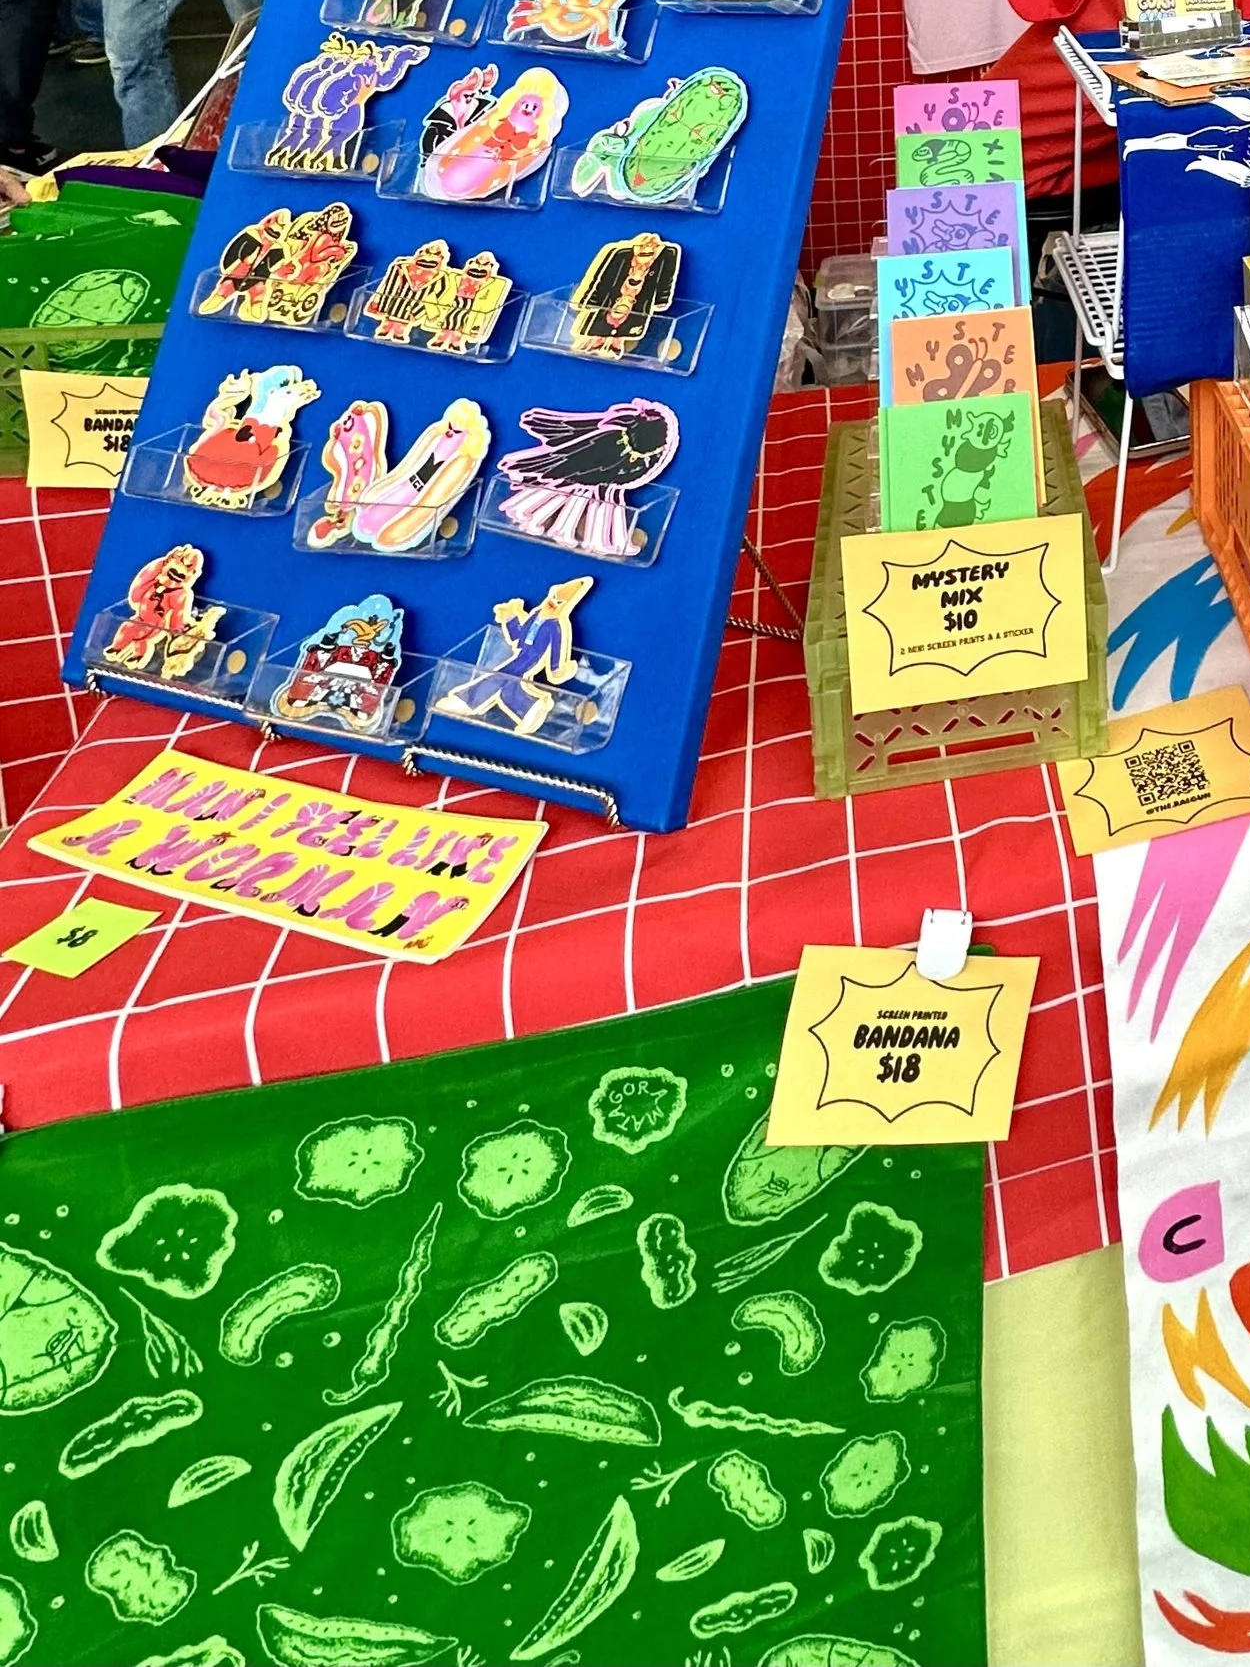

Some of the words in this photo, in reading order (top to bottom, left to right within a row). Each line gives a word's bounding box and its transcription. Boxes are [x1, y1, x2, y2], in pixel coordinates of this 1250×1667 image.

[84, 418, 138, 432] BANDA
[103, 434, 131, 452] $18
[912, 561, 1010, 590] MYSTERY
[941, 586, 983, 608] MIX
[944, 609, 978, 632] $10
[927, 640, 957, 651] SCREEN
[959, 635, 985, 646] PRINTS
[1003, 628, 1034, 638] STICKER
[122, 767, 266, 821] MAN
[270, 801, 399, 858] FEEL
[387, 825, 519, 884] LIKE
[57, 928, 97, 949] $8
[877, 1010, 910, 1020] SCREEN
[912, 1010, 948, 1020] PRINTED
[853, 1024, 960, 1049] BANDANA
[876, 1053, 921, 1083] $18
